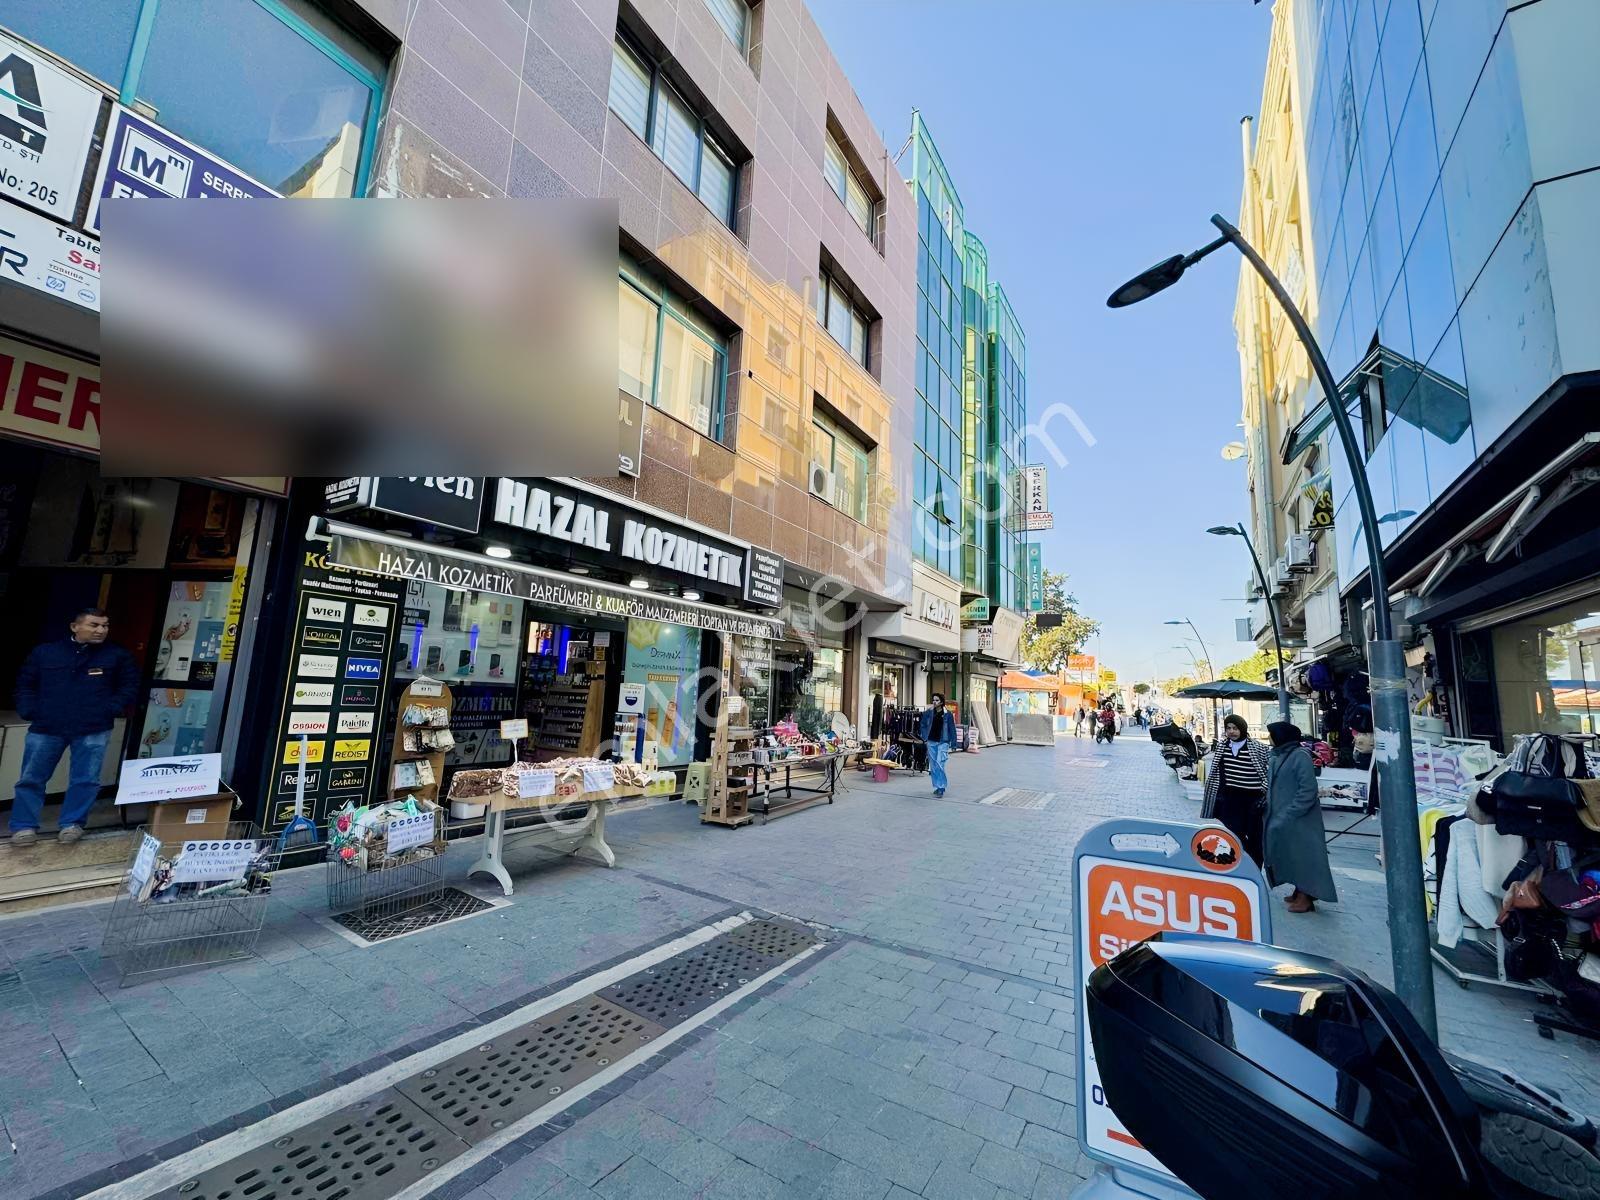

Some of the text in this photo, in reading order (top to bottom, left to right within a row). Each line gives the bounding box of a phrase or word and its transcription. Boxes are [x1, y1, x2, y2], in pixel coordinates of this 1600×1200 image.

[27, 181, 58, 206] 205
[67, 249, 100, 272] Sa
[494, 477, 743, 587] HAZAL KOZMETİK
[378, 552, 434, 582] HAZAL
[438, 564, 514, 595] KOZMETİK
[529, 582, 594, 609] PARFÜMERİ
[595, 594, 603, 610] &
[605, 596, 644, 617] KUAFÖR
[645, 605, 700, 627] MALZEMELERİ
[700, 614, 728, 630] TOPTAN
[311, 606, 342, 618] wien
[348, 663, 379, 674] NIVEA
[284, 773, 317, 786] Reul
[1100, 880, 1239, 937] ASUS
